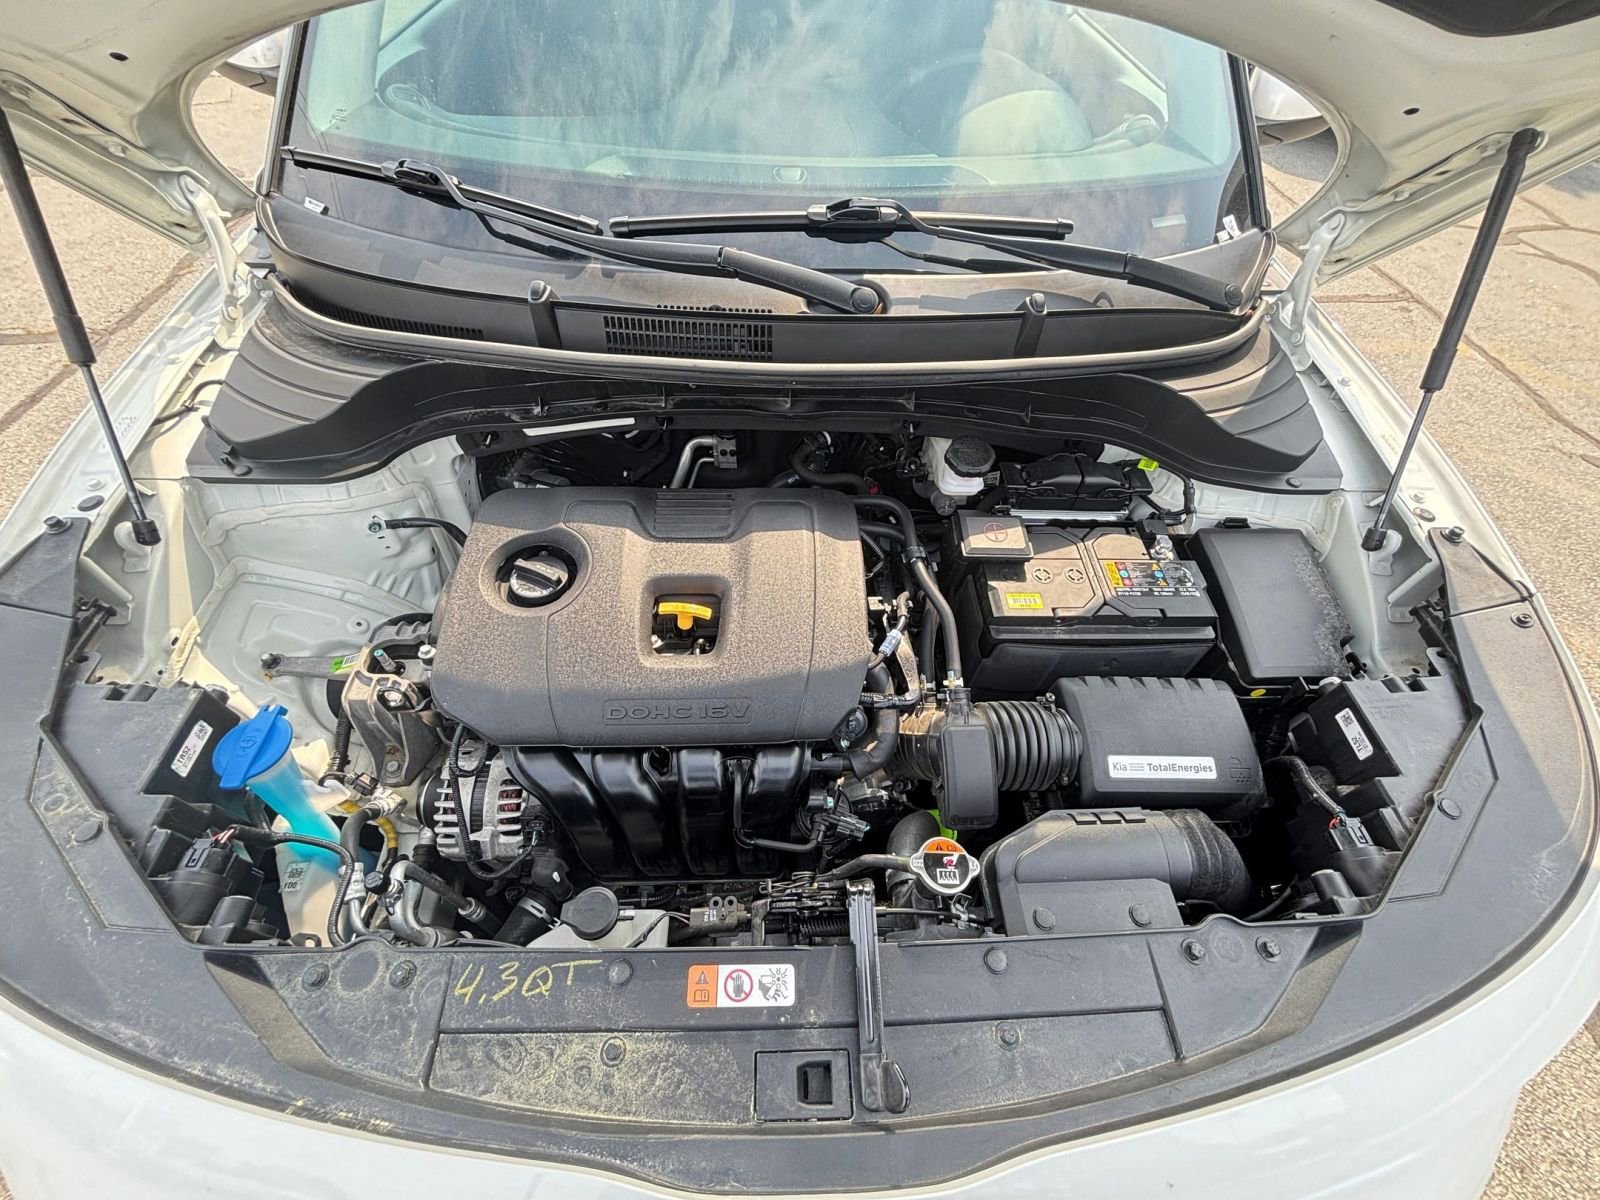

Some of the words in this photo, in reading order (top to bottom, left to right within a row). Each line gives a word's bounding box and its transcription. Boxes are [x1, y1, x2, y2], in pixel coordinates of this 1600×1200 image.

[606, 704, 692, 720] DOHC
[699, 703, 751, 719] 16V
[1112, 761, 1128, 772] Kia
[1146, 762, 1214, 775] TotalEnergies
